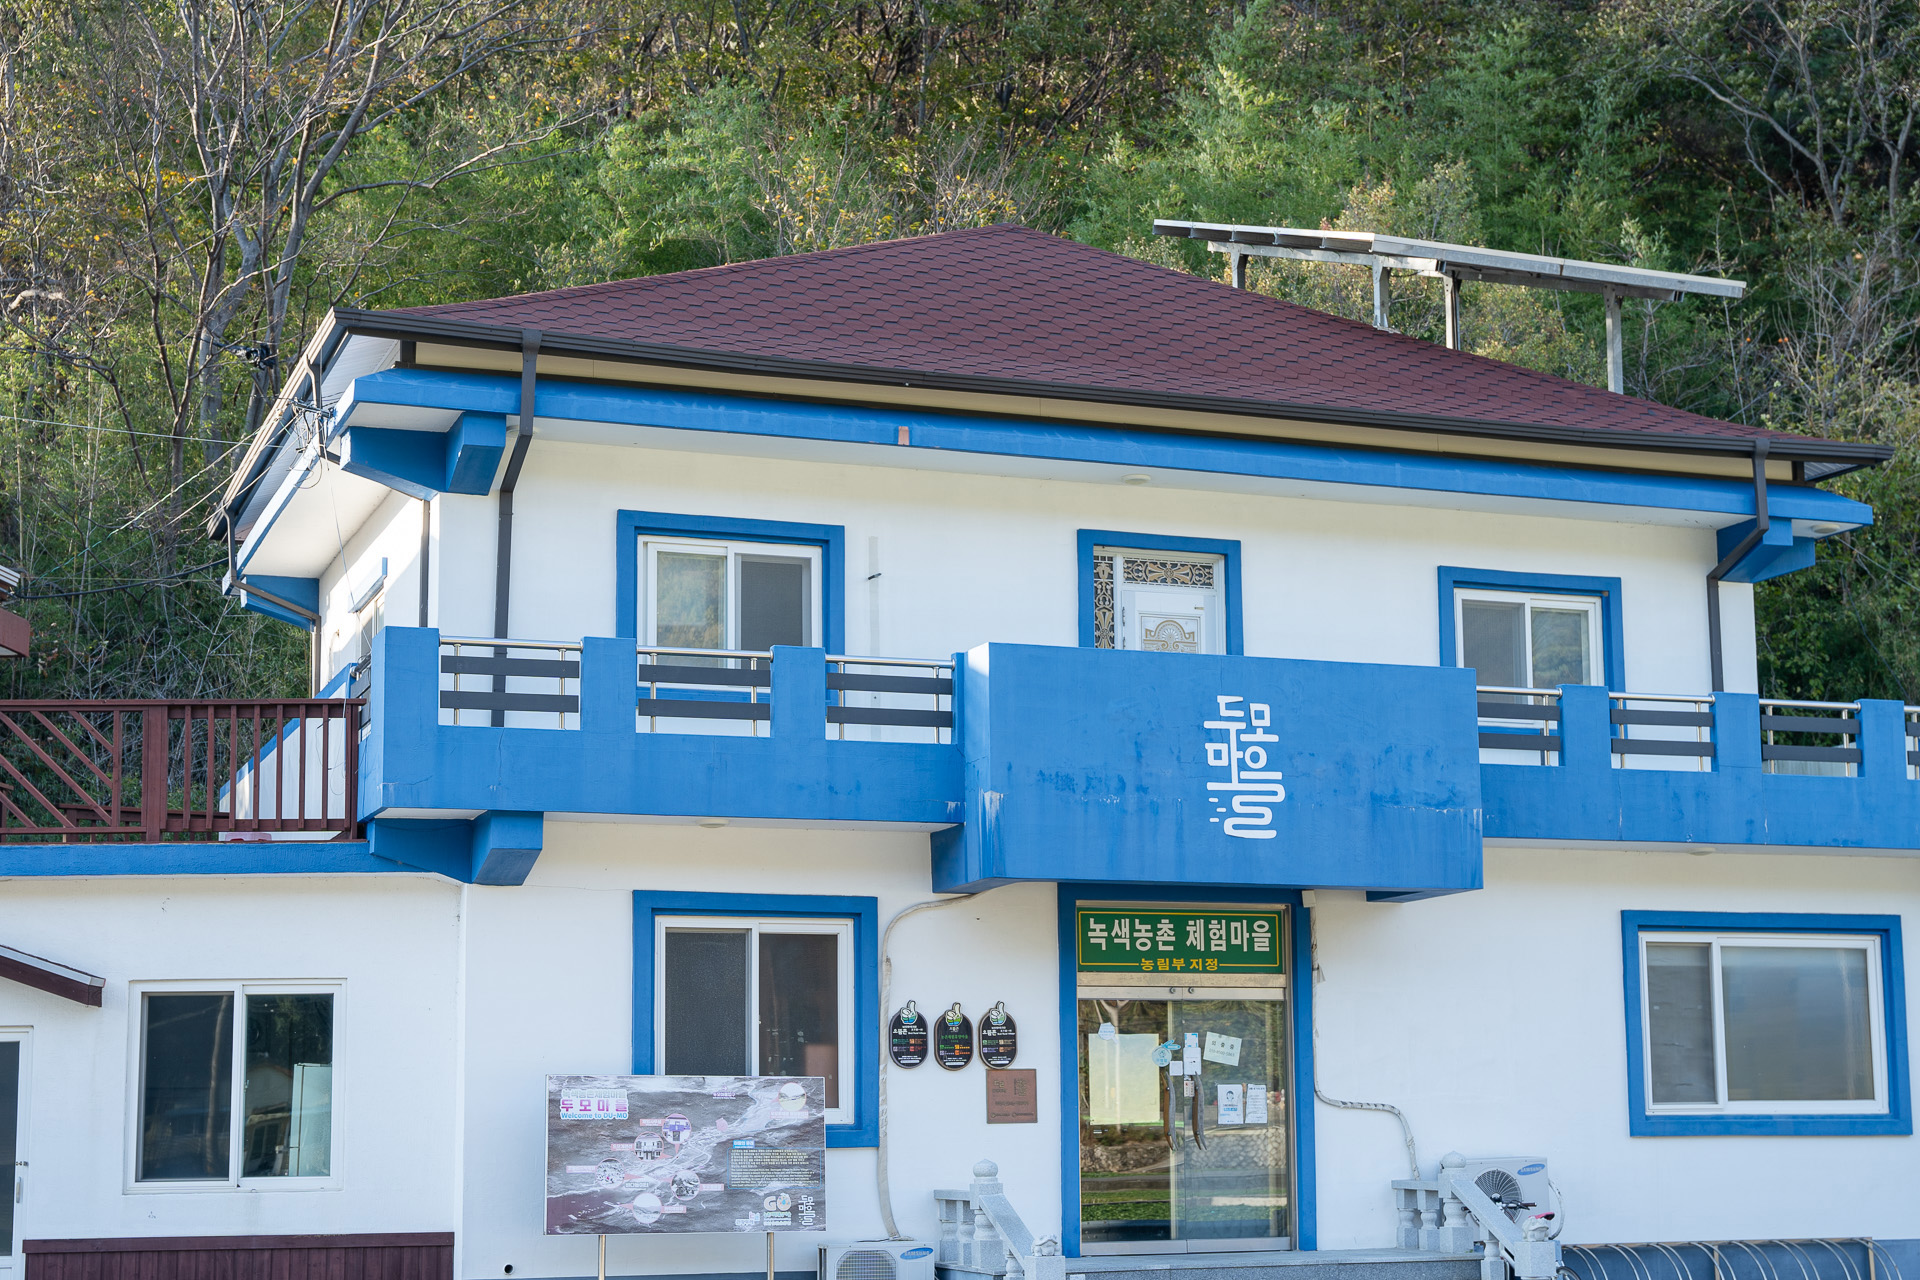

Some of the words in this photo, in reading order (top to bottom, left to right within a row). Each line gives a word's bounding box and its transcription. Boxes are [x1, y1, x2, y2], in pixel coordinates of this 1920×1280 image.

[1087, 917, 1176, 952] 녹색농촌
[1185, 918, 1272, 952] 체험마을
[1140, 957, 1186, 971] 농림부
[1189, 958, 1219, 971] 지정
